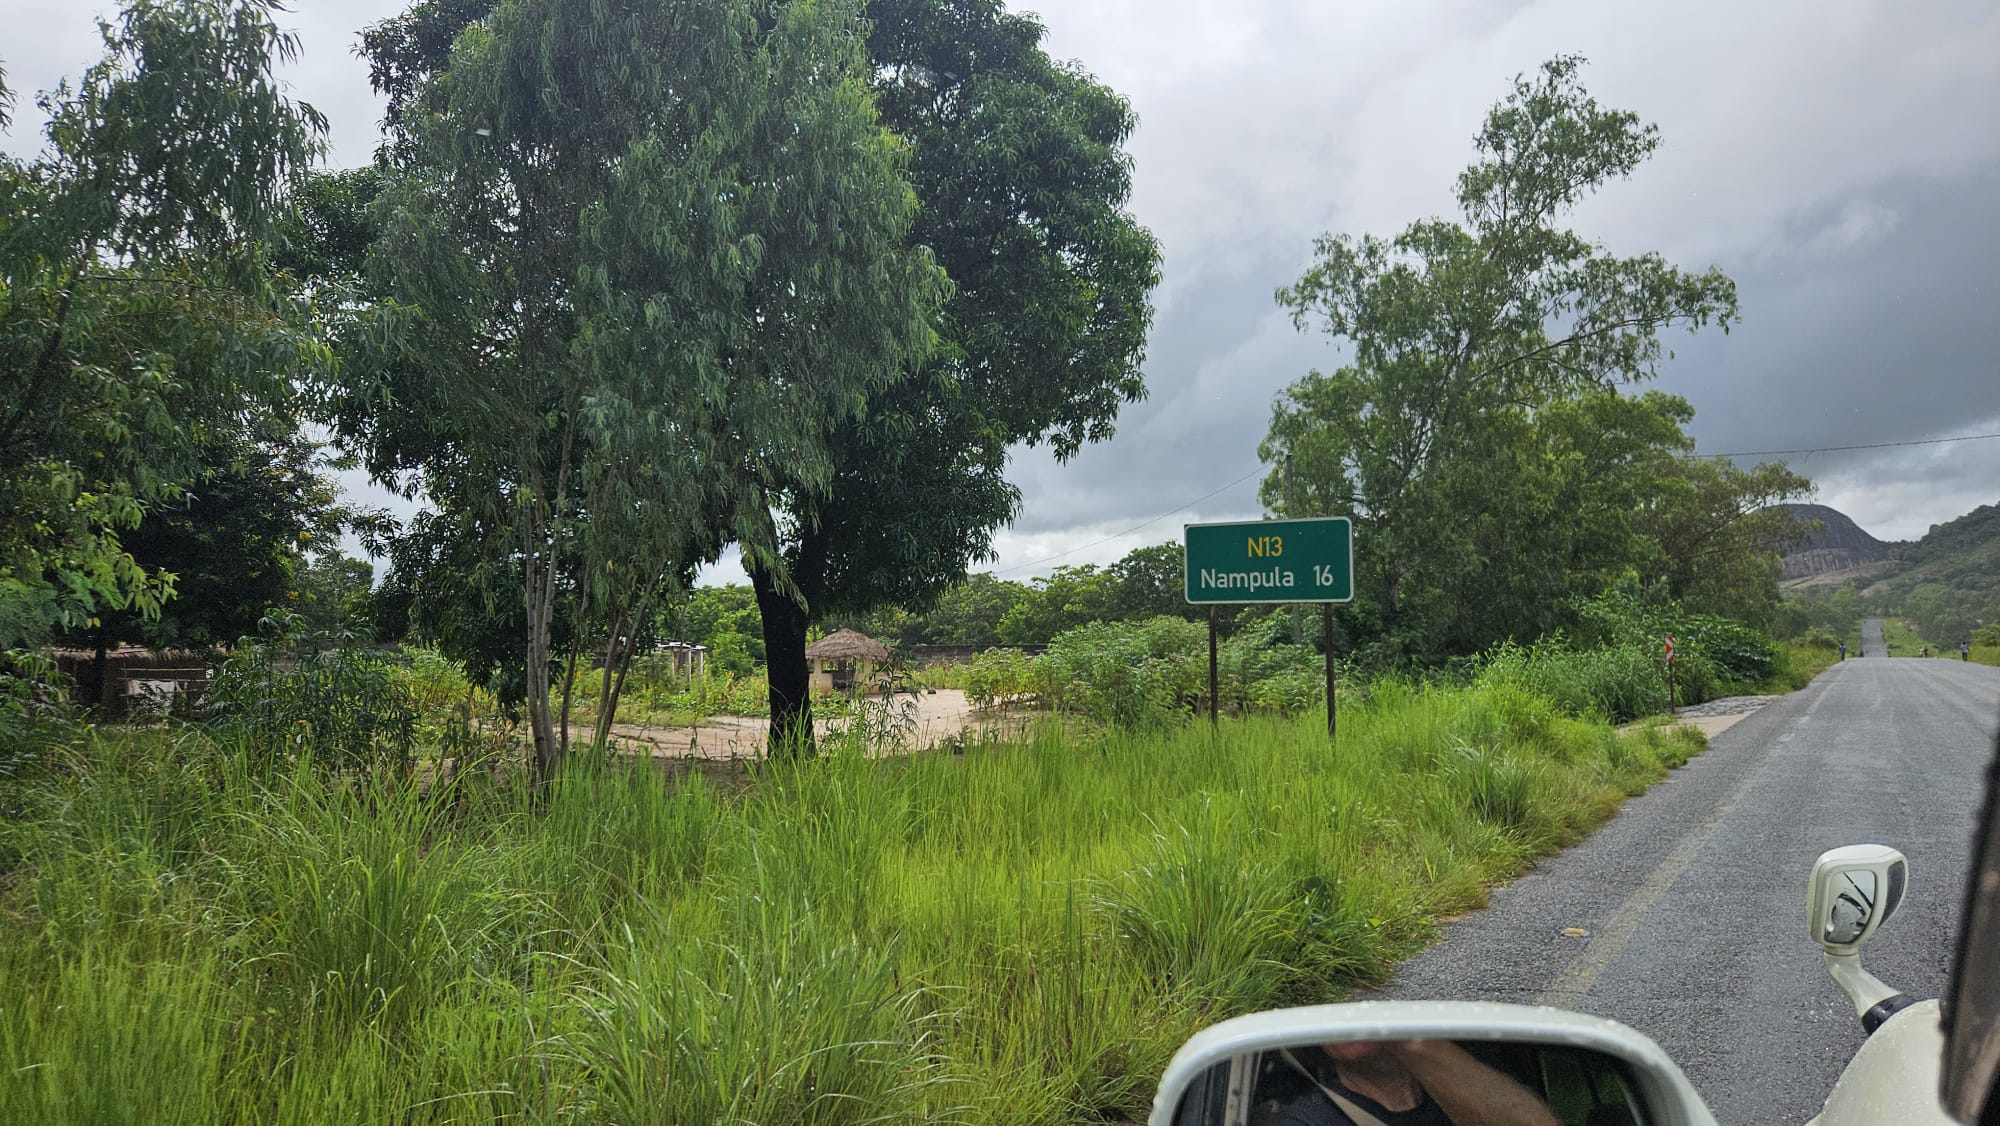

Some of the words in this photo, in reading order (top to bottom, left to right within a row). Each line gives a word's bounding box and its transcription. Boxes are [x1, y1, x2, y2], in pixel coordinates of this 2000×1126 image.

[1247, 536, 1283, 558] N13
[1200, 566, 1294, 593] Nampula
[1313, 564, 1334, 587] 16
